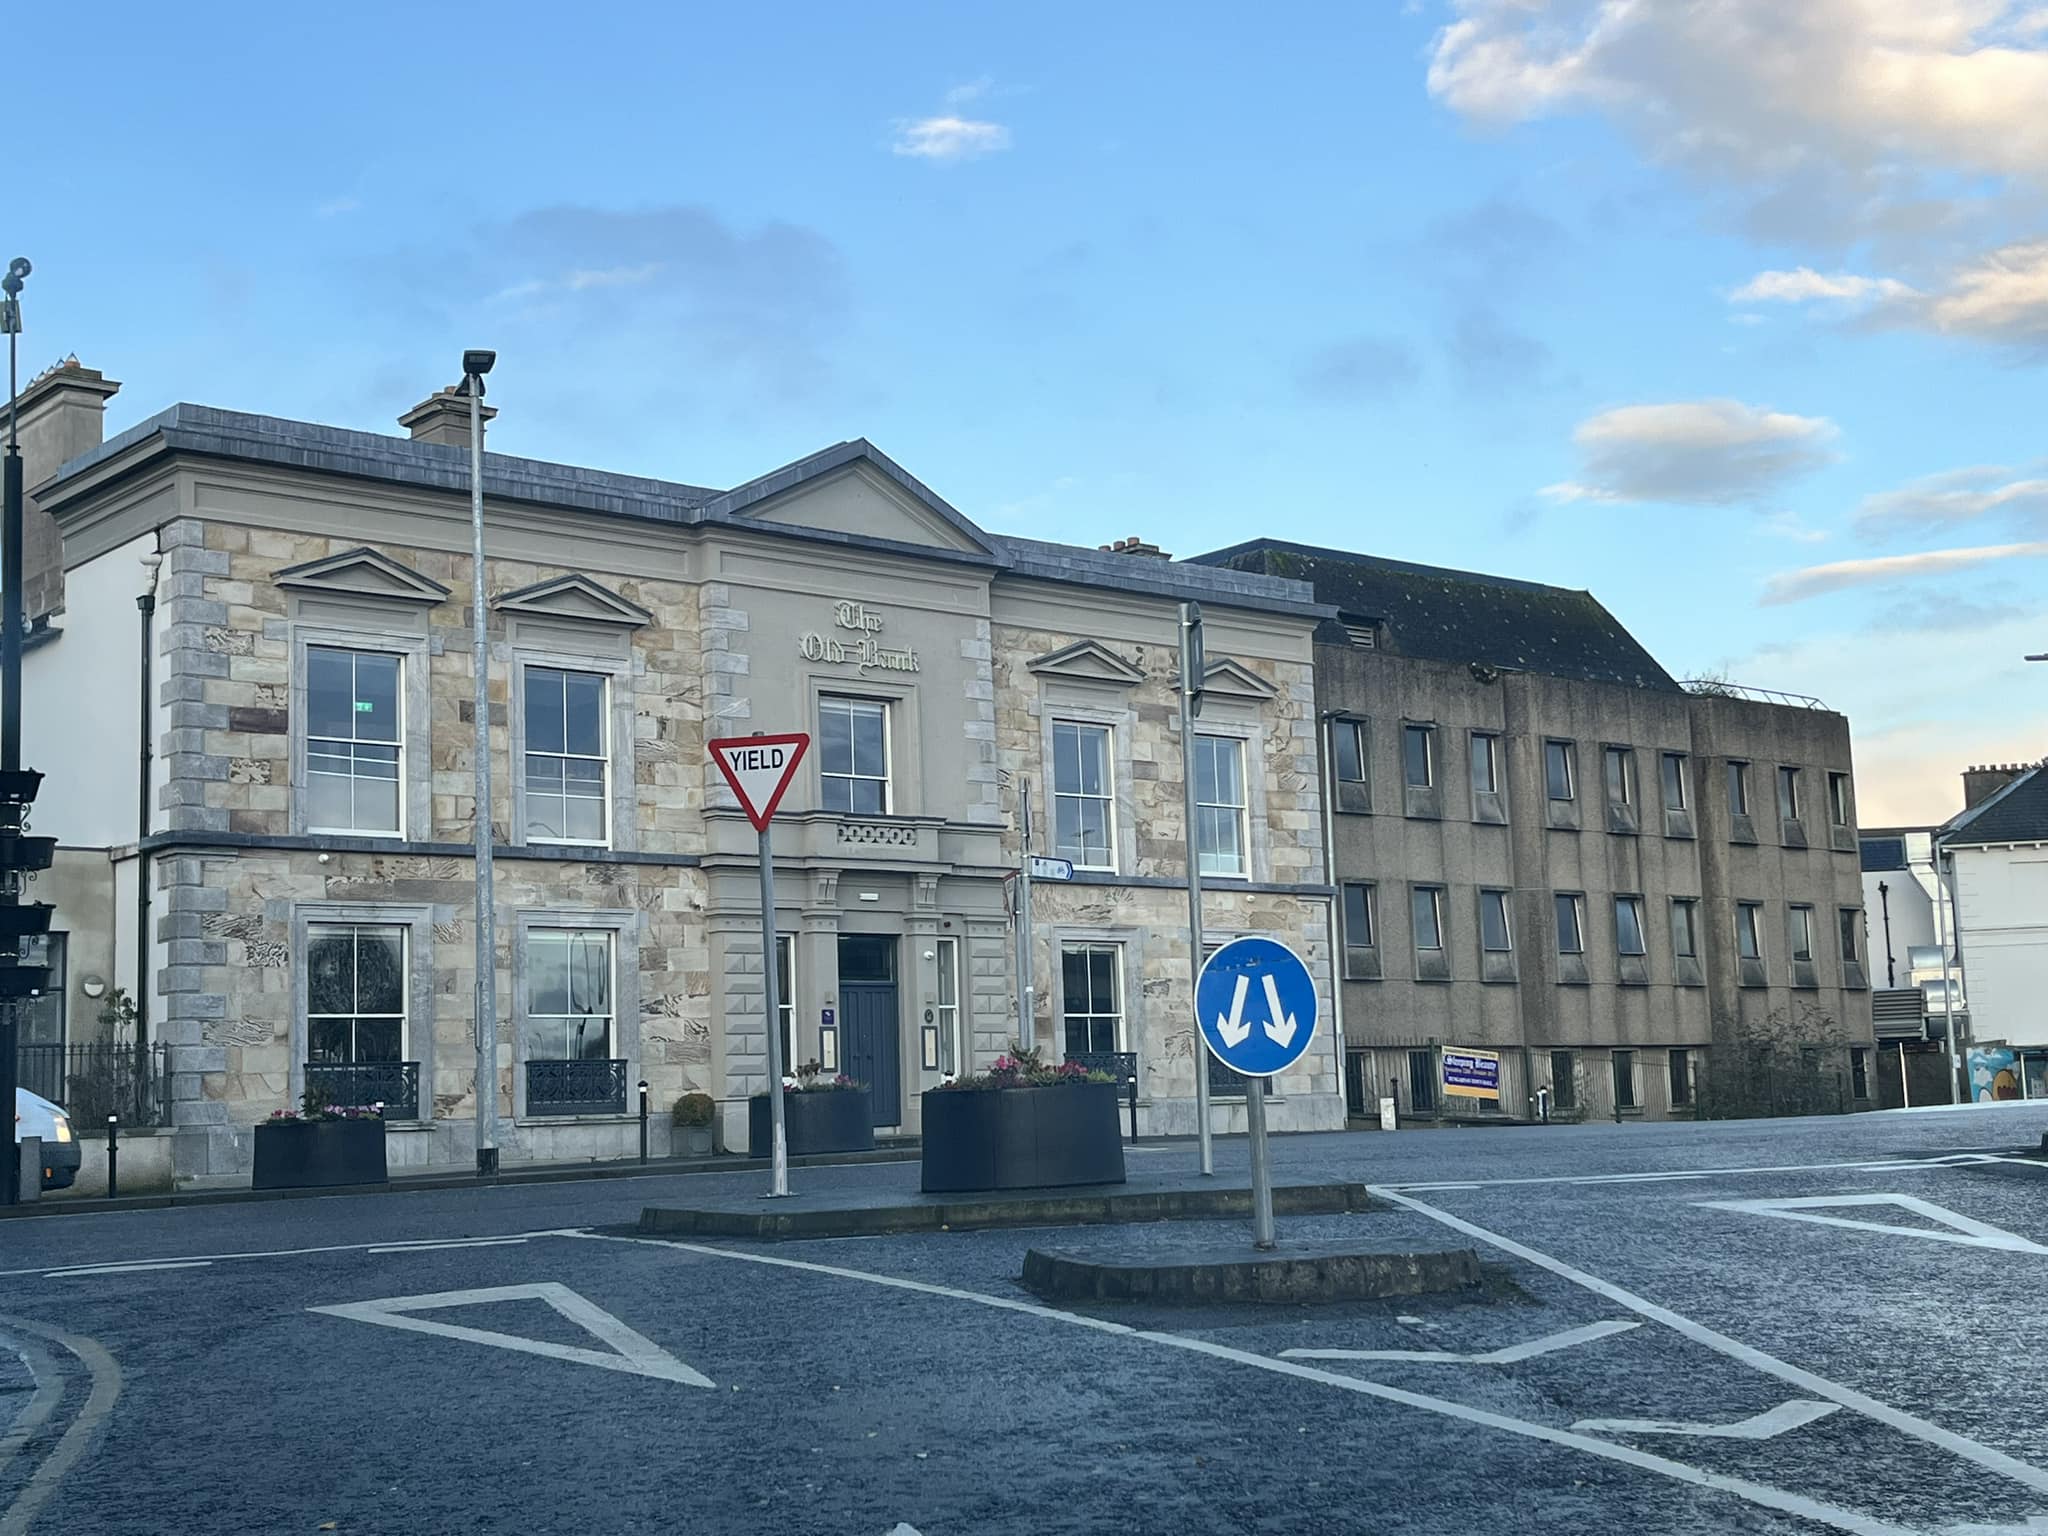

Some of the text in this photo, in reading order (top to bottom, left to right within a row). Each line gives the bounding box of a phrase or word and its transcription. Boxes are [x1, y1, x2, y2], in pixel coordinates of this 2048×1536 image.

[834, 600, 881, 639] The
[799, 632, 920, 676] Old Bank
[730, 749, 783, 771] YIELD
